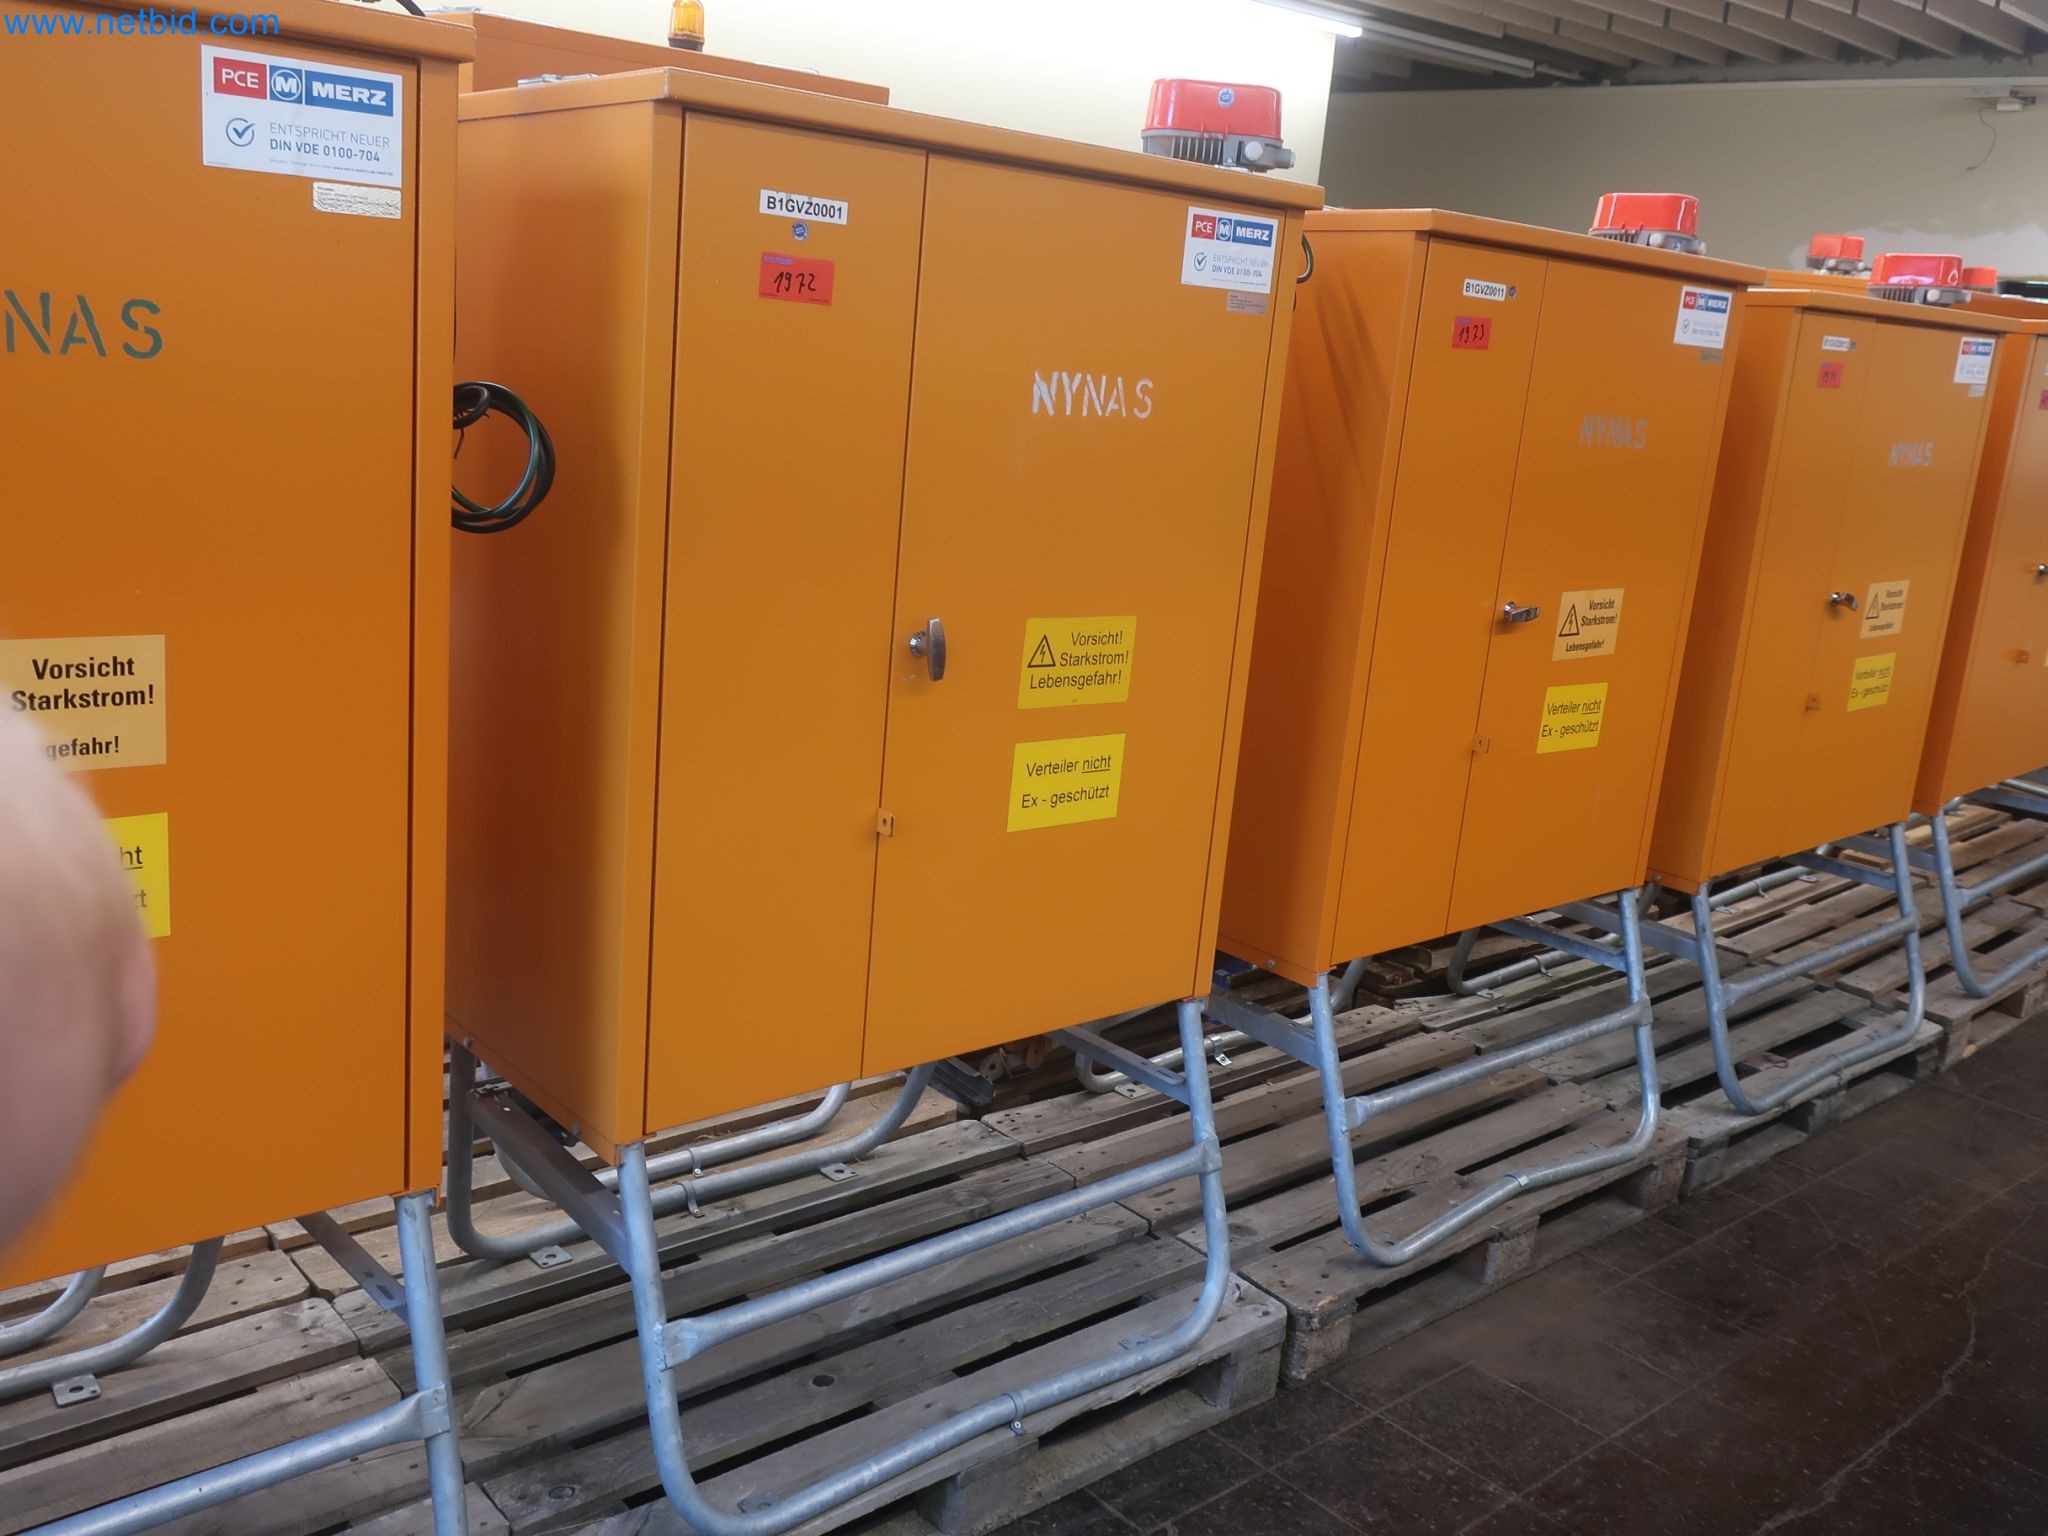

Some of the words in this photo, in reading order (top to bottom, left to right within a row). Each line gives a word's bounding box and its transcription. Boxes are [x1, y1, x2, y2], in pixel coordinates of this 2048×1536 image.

[221, 68, 259, 89] PCE
[312, 81, 387, 106] MERZ
[269, 122, 346, 142] ENTSPRICHT
[350, 131, 390, 148] NEUER
[270, 138, 292, 152] DIN
[295, 141, 319, 156] VDE
[323, 145, 380, 162] 0100-704
[766, 196, 842, 219] B1GVZ0001
[1195, 220, 1213, 233] PCE
[1235, 226, 1270, 241] MERZ
[1212, 264, 1223, 273] DIN
[1224, 266, 1236, 275] VDE
[1213, 253, 1248, 265] ENTSPRICHT
[774, 271, 816, 294] 1972
[1465, 282, 1504, 298] B1GVZ0011
[1032, 370, 1153, 419] NYNAS
[1579, 415, 1648, 448] NYNAS
[1589, 599, 1615, 610] Vorsicht
[1581, 613, 1618, 626] Starkstrom!
[1071, 630, 1123, 647] Vorsicht!
[1566, 639, 1605, 652] Lebensgefahr!
[32, 656, 135, 680] Vorsicht
[1059, 650, 1129, 667] Starkstrom!
[1029, 670, 1122, 690] Lebensgefahr!
[11, 684, 154, 712] Starkstrom!
[1547, 701, 1581, 715] Verteiler
[1582, 699, 1601, 712] nicht
[1541, 724, 1552, 737] Ex
[1560, 720, 1599, 738] geschützt
[45, 735, 119, 761] gefahr!
[1026, 759, 1079, 777] Verteiler
[1082, 755, 1111, 771] nicht
[1021, 794, 1038, 809] Ex
[1050, 785, 1110, 808] geschützt
